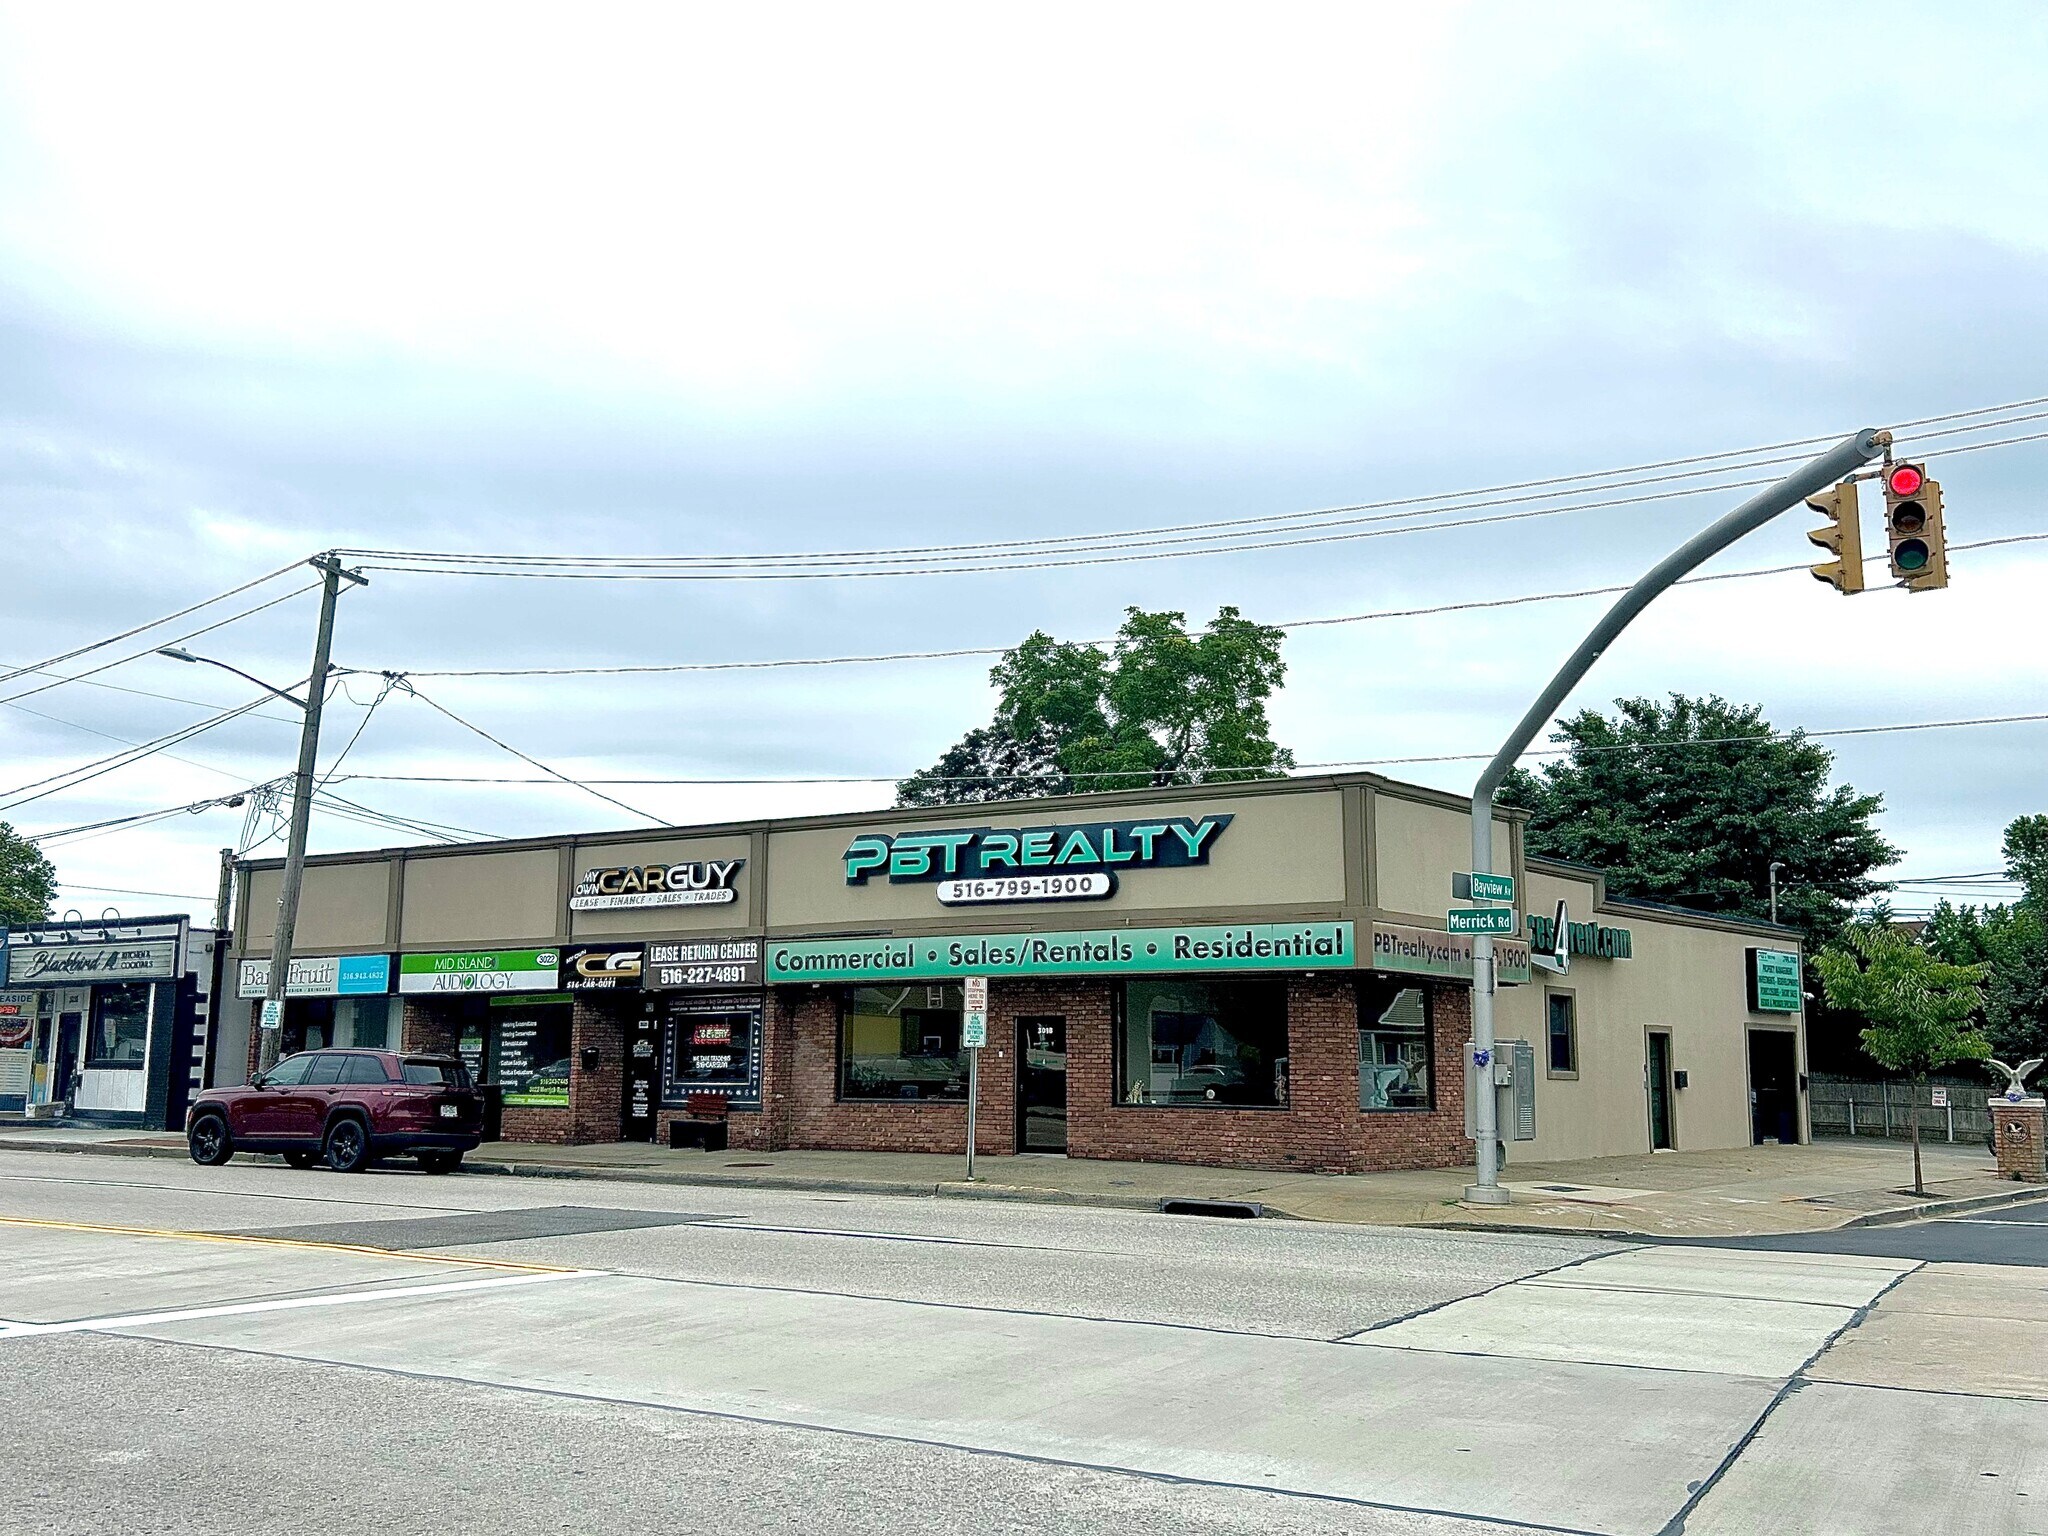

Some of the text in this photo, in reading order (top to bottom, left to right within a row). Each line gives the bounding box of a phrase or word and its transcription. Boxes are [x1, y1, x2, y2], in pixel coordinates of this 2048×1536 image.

[847, 821, 1217, 878] PBT REALTY
[583, 871, 600, 883] MY
[575, 883, 600, 895] OWN
[952, 876, 1093, 899] 516-799-1900
[1474, 878, 1503, 897] Bayview
[574, 890, 728, 908] LEASE FINANCE SALES TRADES
[1450, 913, 1510, 929] Merrick Rd
[650, 942, 758, 962] LEASE RETURN CENTER
[775, 927, 1344, 972] Commercial Sales/Rentals Residential
[1373, 932, 1462, 965] PBTrealty.com
[24, 950, 106, 978] Blackbird
[121, 960, 154, 970] COCKTAILS
[434, 956, 493, 970] MID ISLAND
[538, 954, 556, 964] 3022
[286, 961, 335, 985] Fruit
[433, 972, 514, 991] AUDIOLOGY
[660, 966, 746, 985] 516-227-4891
[972, 980, 981, 988] NO
[0, 994, 32, 1003] EASIDE
[0, 1005, 18, 1014] PEN
